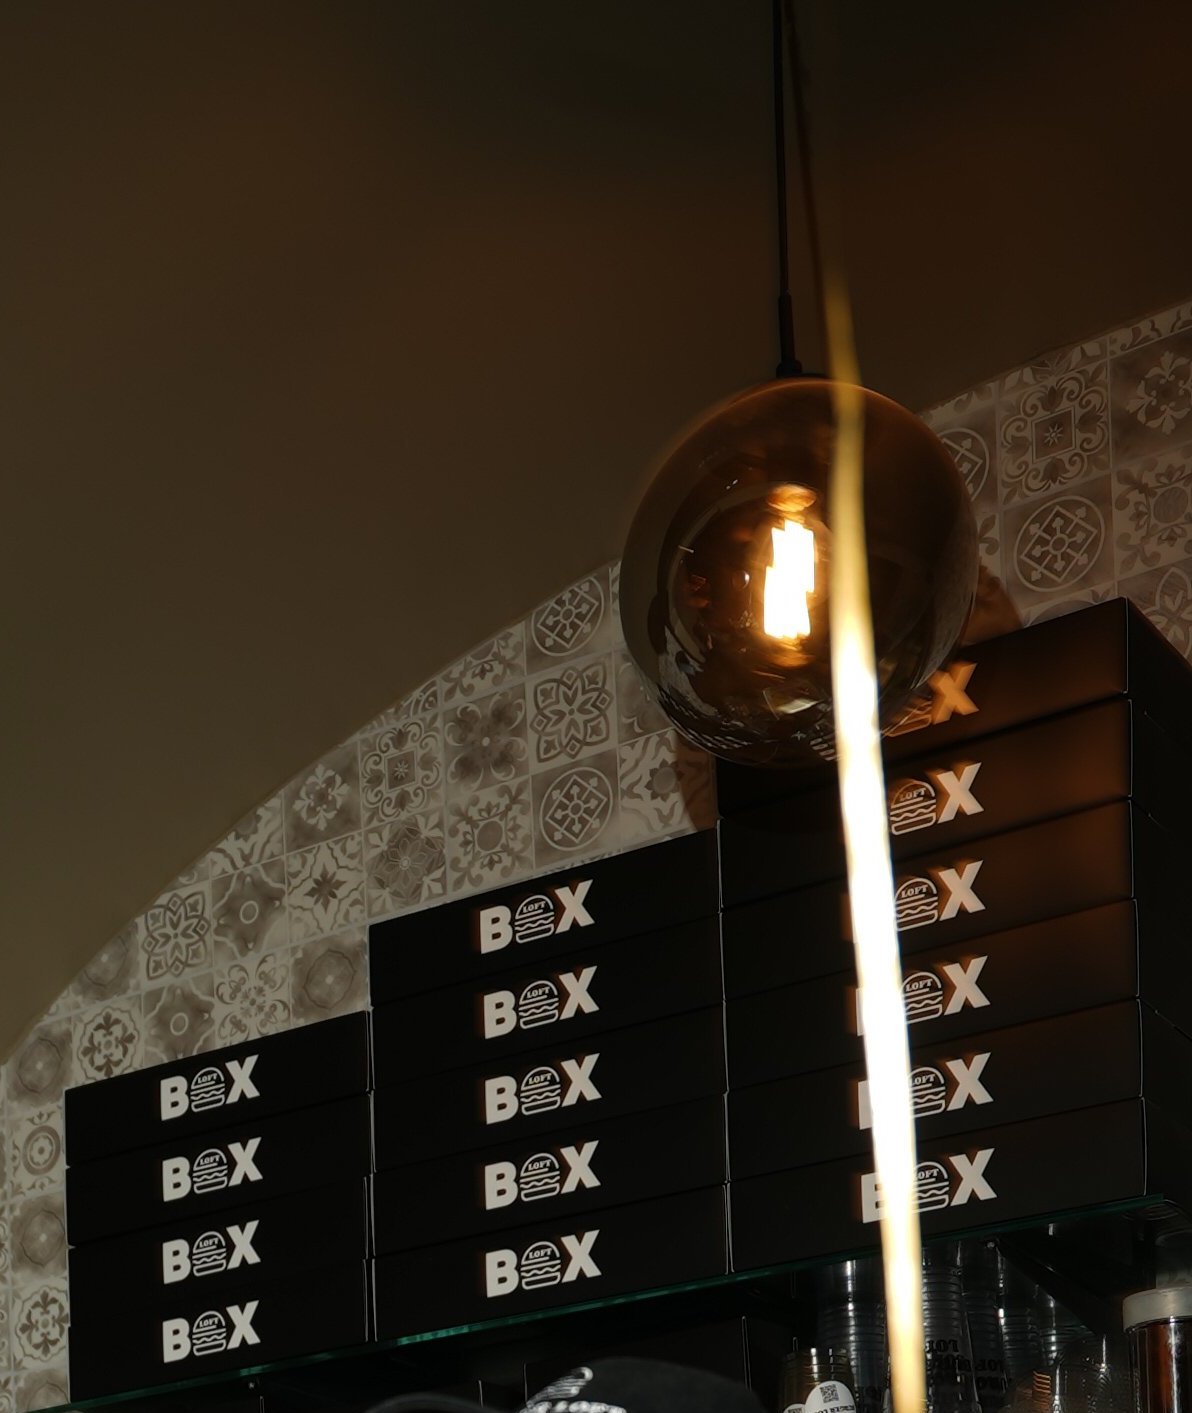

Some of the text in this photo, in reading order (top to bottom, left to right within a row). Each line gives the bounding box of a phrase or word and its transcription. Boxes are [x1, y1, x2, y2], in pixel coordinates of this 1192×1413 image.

[899, 787, 927, 801] LOFT
[901, 884, 929, 898] LOFT
[522, 900, 546, 913] LOFT
[905, 978, 933, 992] LOFT
[526, 986, 551, 999] LOFT
[197, 1072, 218, 1084] LOFT
[528, 1072, 553, 1085] LOFT
[199, 1154, 220, 1166] LOFT
[528, 1159, 552, 1171] LOFT
[916, 1168, 940, 1181] OFT
[199, 1237, 219, 1248] LOFT
[528, 1247, 552, 1259] LOFT
[199, 1317, 219, 1328] LOFT
